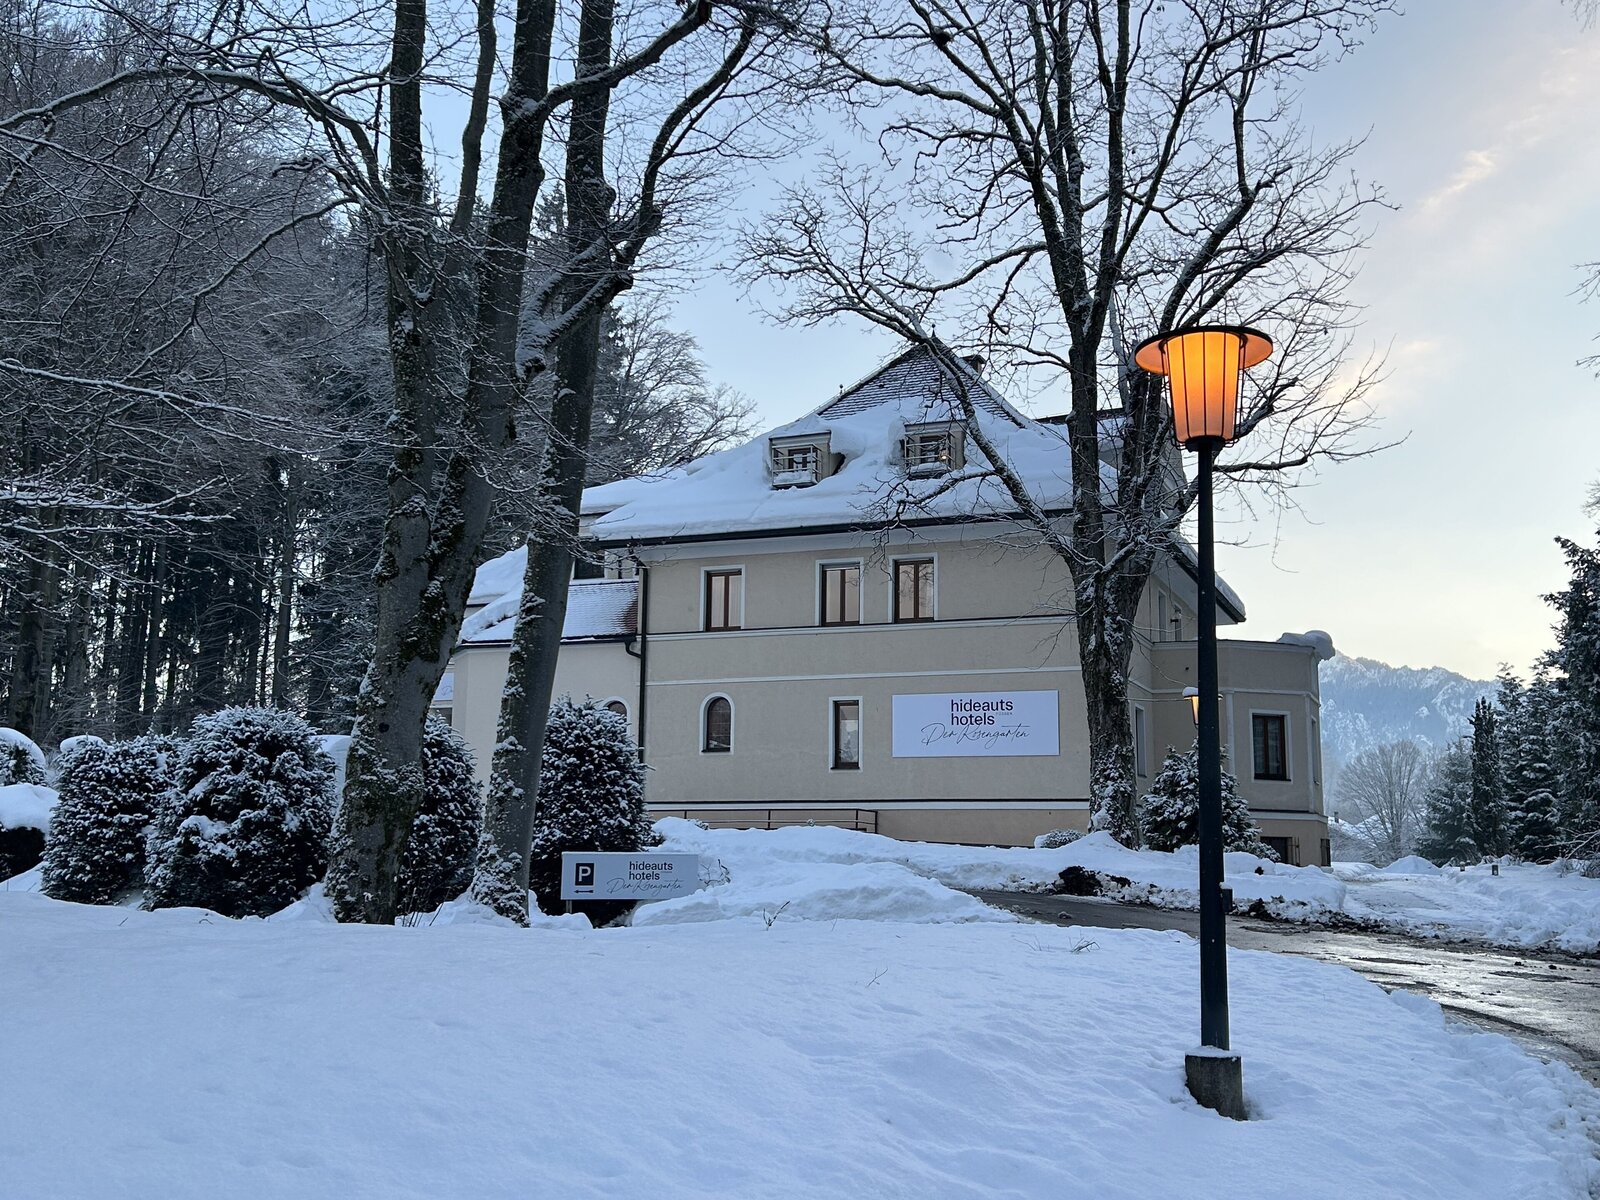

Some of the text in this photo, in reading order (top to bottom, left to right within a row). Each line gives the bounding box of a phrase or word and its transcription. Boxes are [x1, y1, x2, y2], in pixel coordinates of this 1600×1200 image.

[951, 698, 1014, 712] hideauts
[951, 712, 995, 726] hotels
[921, 722, 958, 746] Der
[629, 860, 673, 871] hideauts
[578, 866, 591, 882] P
[628, 871, 661, 881] hotels
